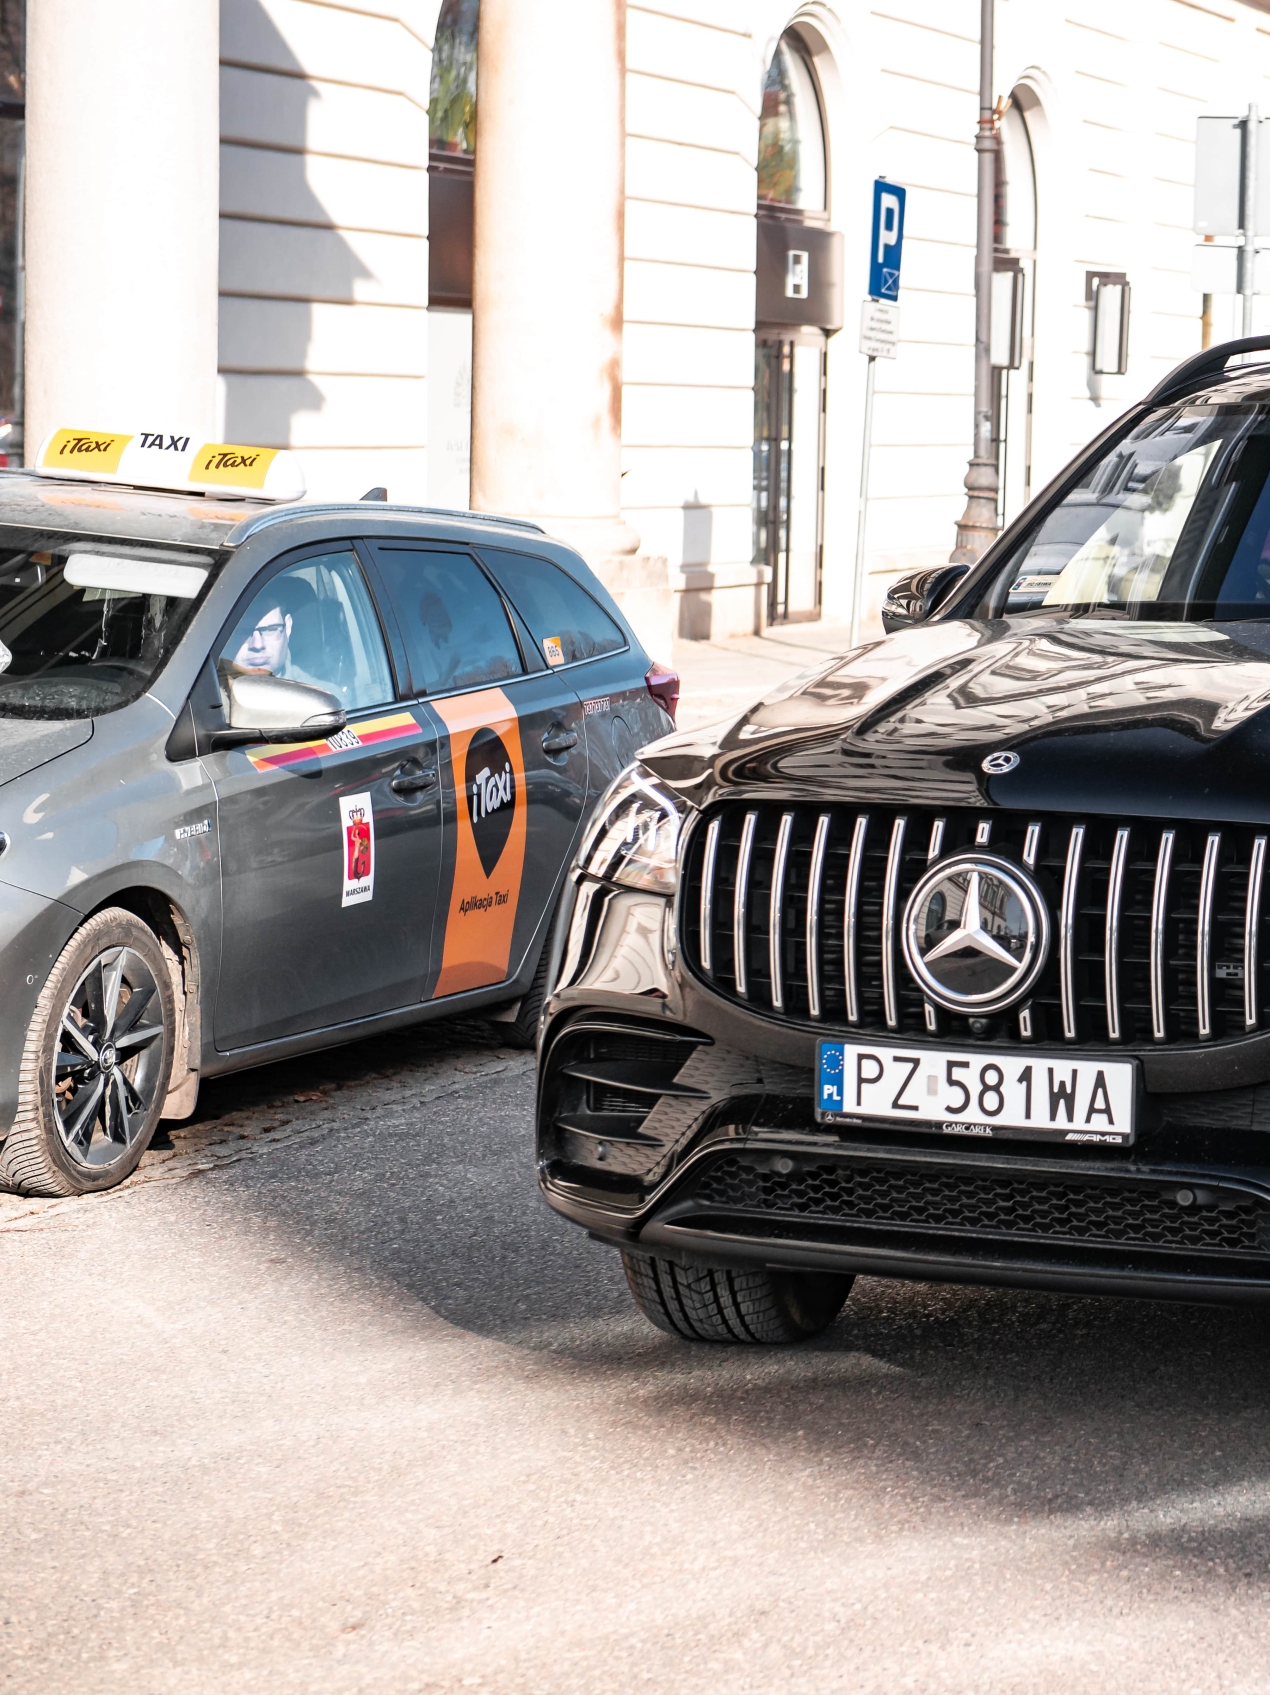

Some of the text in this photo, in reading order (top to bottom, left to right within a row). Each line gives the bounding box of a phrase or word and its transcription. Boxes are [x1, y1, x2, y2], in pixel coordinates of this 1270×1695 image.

[877, 192, 900, 264] P
[59, 437, 115, 455] iTaxi
[139, 432, 190, 452] TAXI
[204, 452, 260, 470] iTaxi
[326, 729, 360, 750] 10839
[472, 761, 512, 824] iTaxi
[175, 819, 211, 840] HYBRID
[345, 884, 371, 898] WARSZAWA
[458, 889, 510, 916] Aplikacja Taxi
[822, 1084, 841, 1101] PL
[856, 1053, 1115, 1126] PZ 581WA
[942, 1122, 993, 1135] GARCAREK
[1083, 1133, 1122, 1143] AMG
